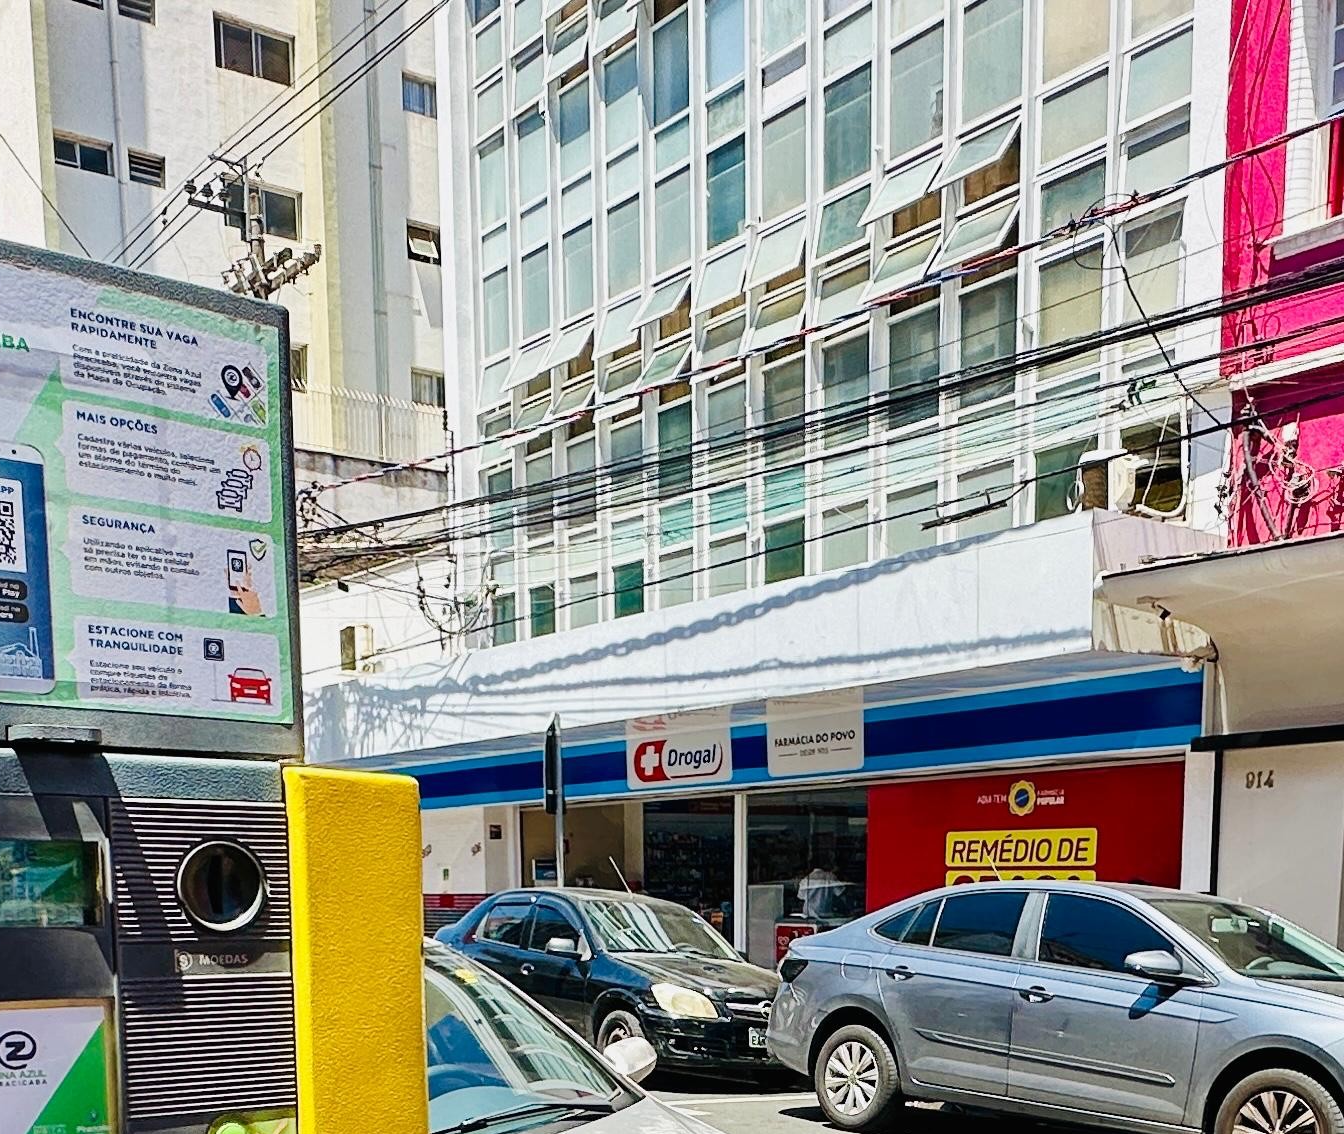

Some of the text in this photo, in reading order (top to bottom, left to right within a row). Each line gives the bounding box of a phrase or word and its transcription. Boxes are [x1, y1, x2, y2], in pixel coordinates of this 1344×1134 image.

[70, 308, 199, 346] ENCONTRE SUA VAGA
[71, 322, 157, 349] RAPIDAMENTE
[76, 410, 158, 434] MAIS OPÇÕES
[81, 514, 156, 534] SEGURANÇA
[88, 624, 183, 642] ESTACIONE COM
[89, 638, 183, 656] TRANQUILIDADE
[775, 729, 856, 748] FARMÁCIA DO POVO
[667, 744, 716, 769] Drogal
[1037, 796, 1065, 806] POPULAR
[952, 834, 1090, 863] REMÉDIO DE
[198, 953, 249, 966] MOEDAS
[19, 1069, 47, 1078] AZUL
